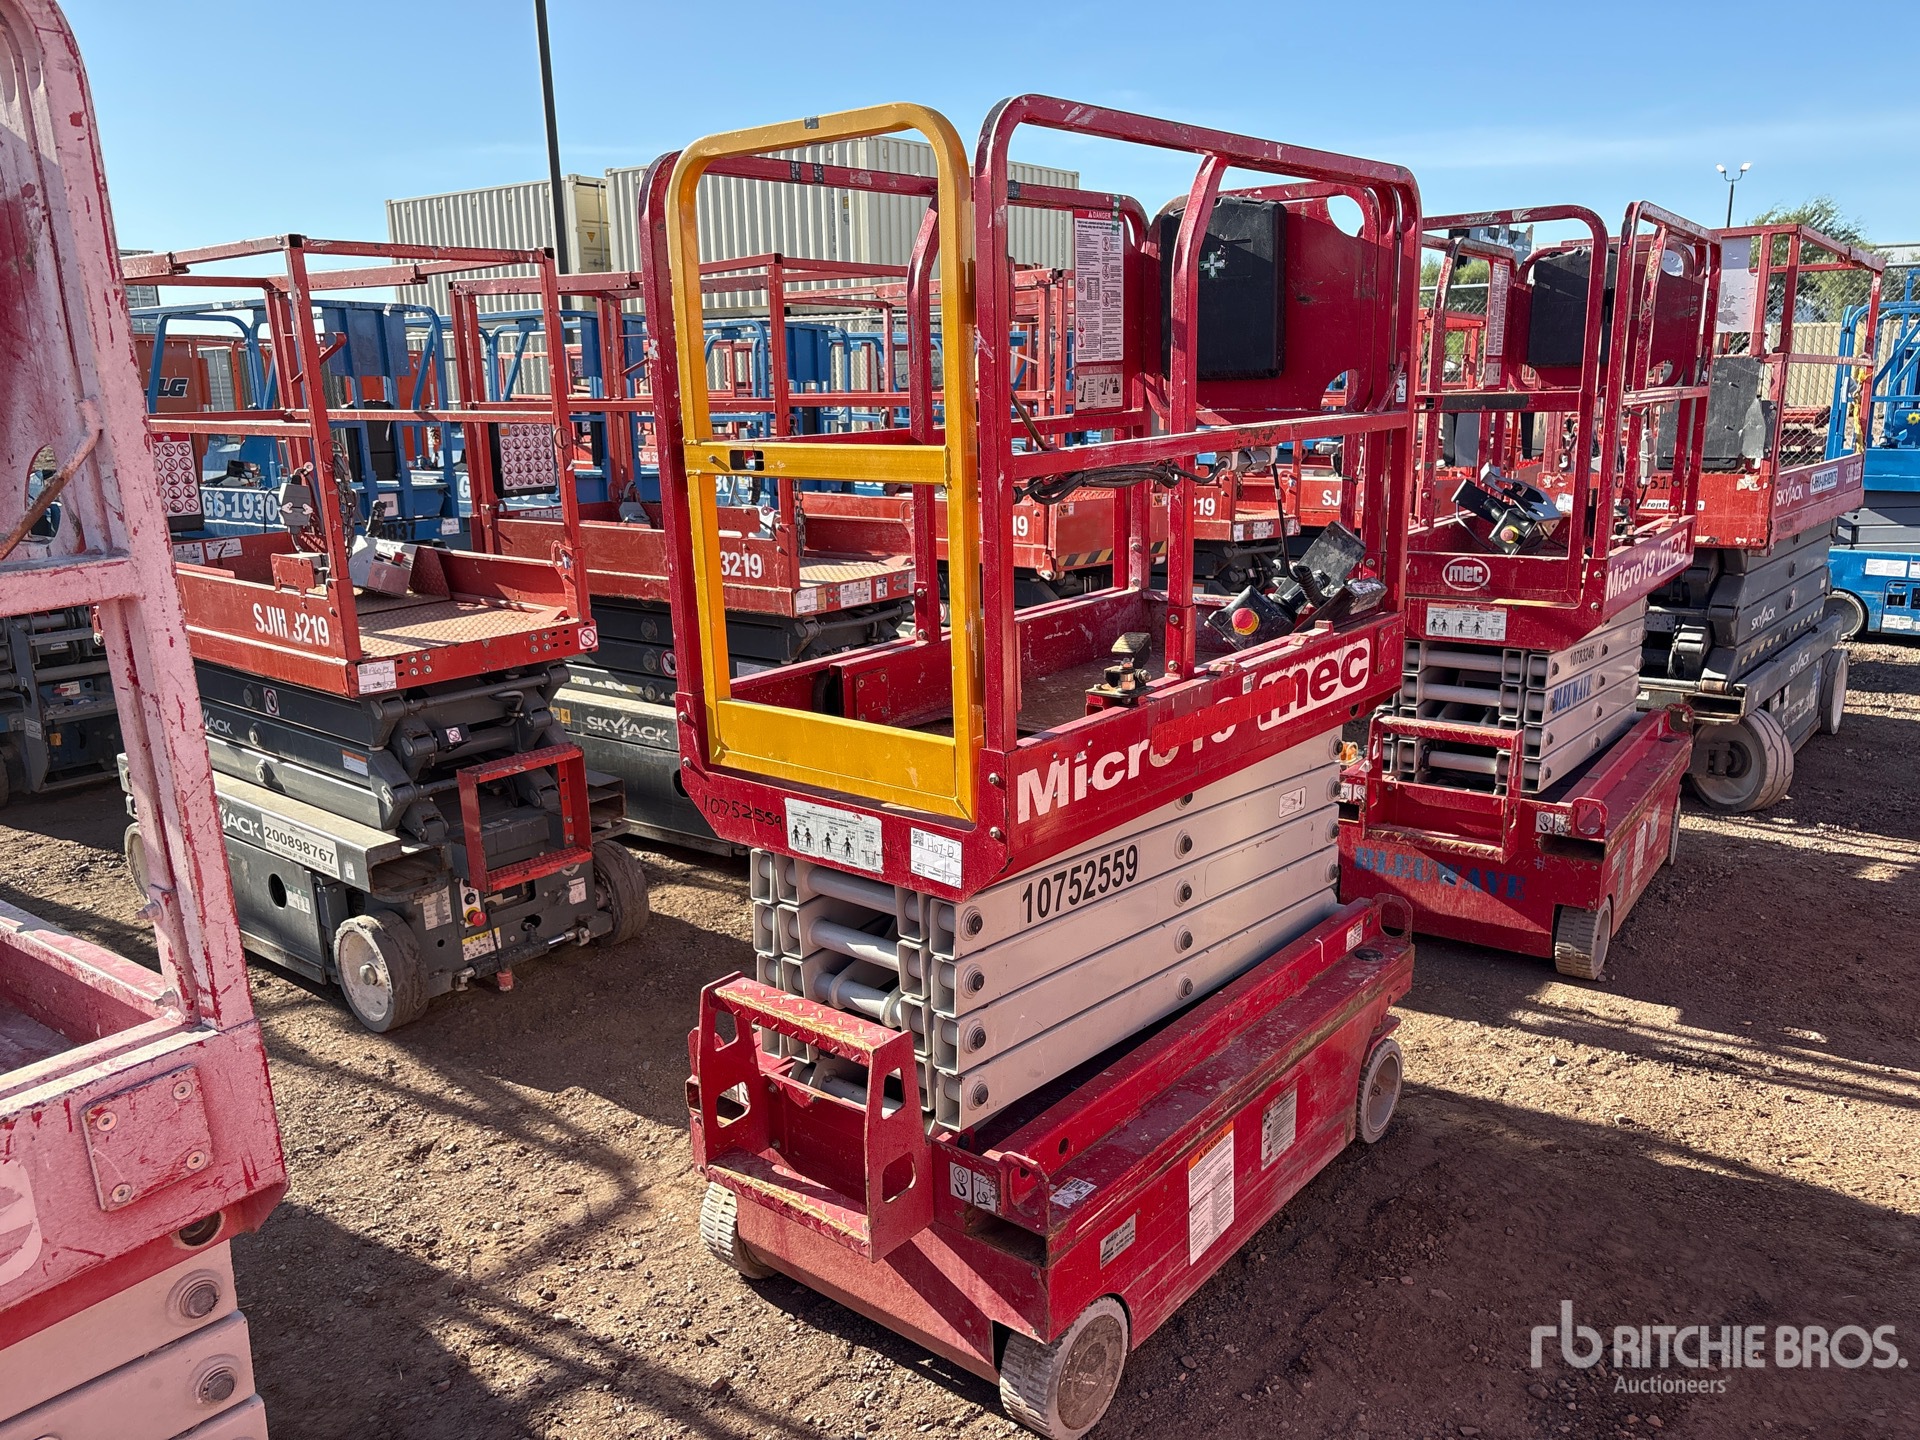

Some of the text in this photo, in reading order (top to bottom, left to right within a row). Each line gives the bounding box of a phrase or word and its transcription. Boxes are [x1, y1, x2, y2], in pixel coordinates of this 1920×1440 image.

[1092, 211, 1112, 220] DANGER
[145, 378, 189, 398] LG
[201, 490, 278, 521] GS-1930
[1775, 480, 1804, 507] SKYJACK
[720, 550, 763, 579] 3219
[1448, 565, 1483, 582] mec
[292, 611, 331, 648] 3219
[1750, 603, 1776, 631] SKYJACK
[585, 715, 671, 743] SKYJACK
[704, 794, 783, 833] 10752559
[264, 826, 334, 865] 200898767
[1021, 843, 1138, 924] 10752559
